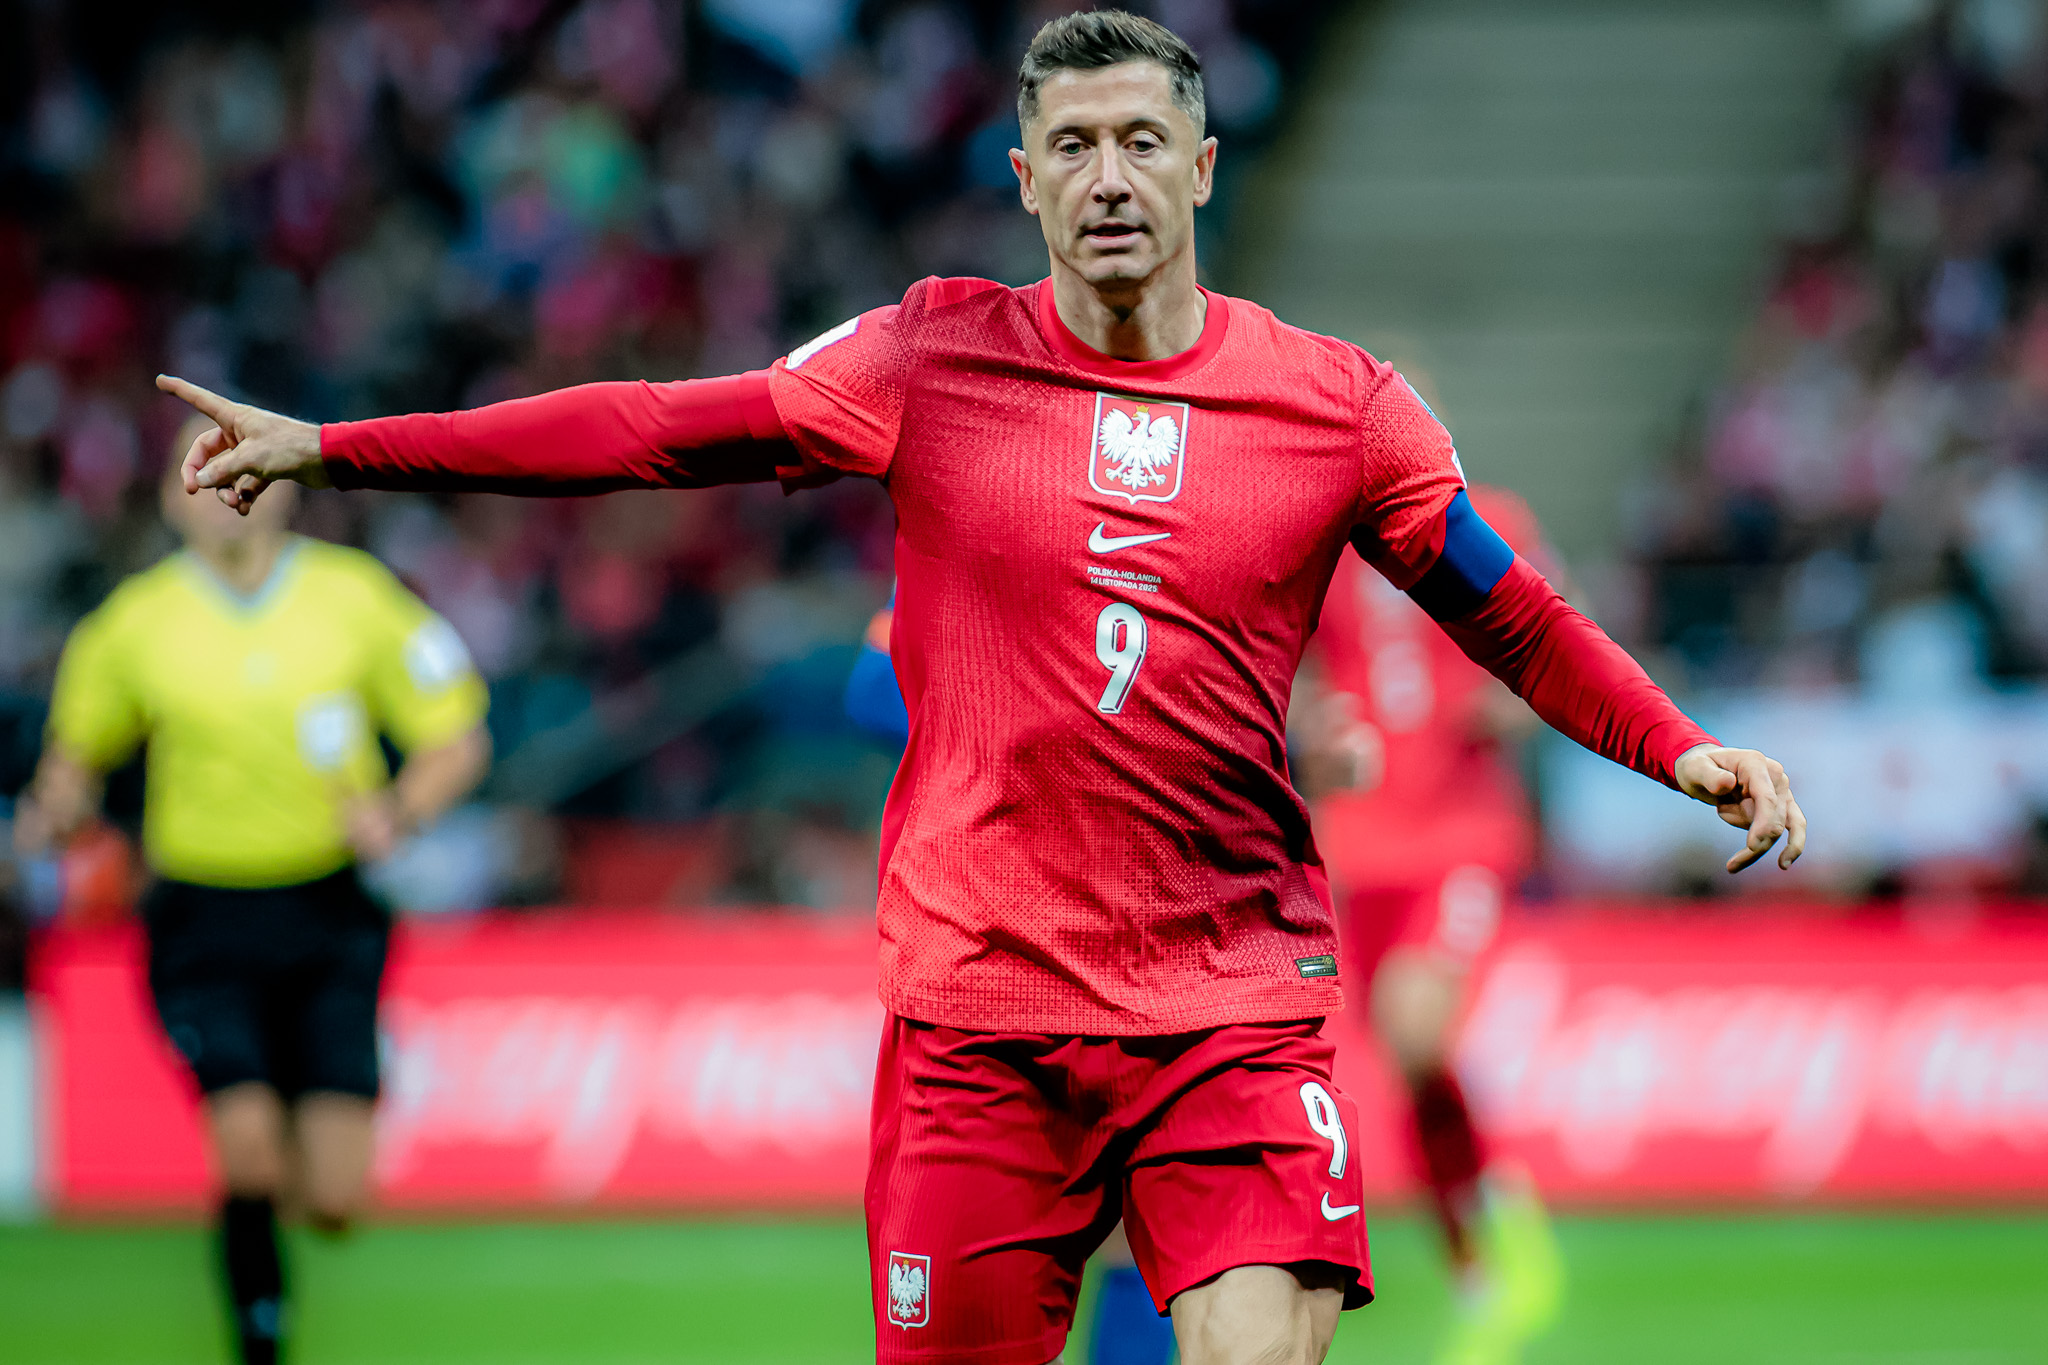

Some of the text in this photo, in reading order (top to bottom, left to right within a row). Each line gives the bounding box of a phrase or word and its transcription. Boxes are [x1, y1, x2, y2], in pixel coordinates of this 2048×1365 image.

[1087, 566, 1162, 583] POLSKA-HOLANDIA
[1090, 576, 1158, 593] 14 LISTOPADA 2025
[1095, 602, 1148, 714] 9
[1299, 1081, 1348, 1180] 9
